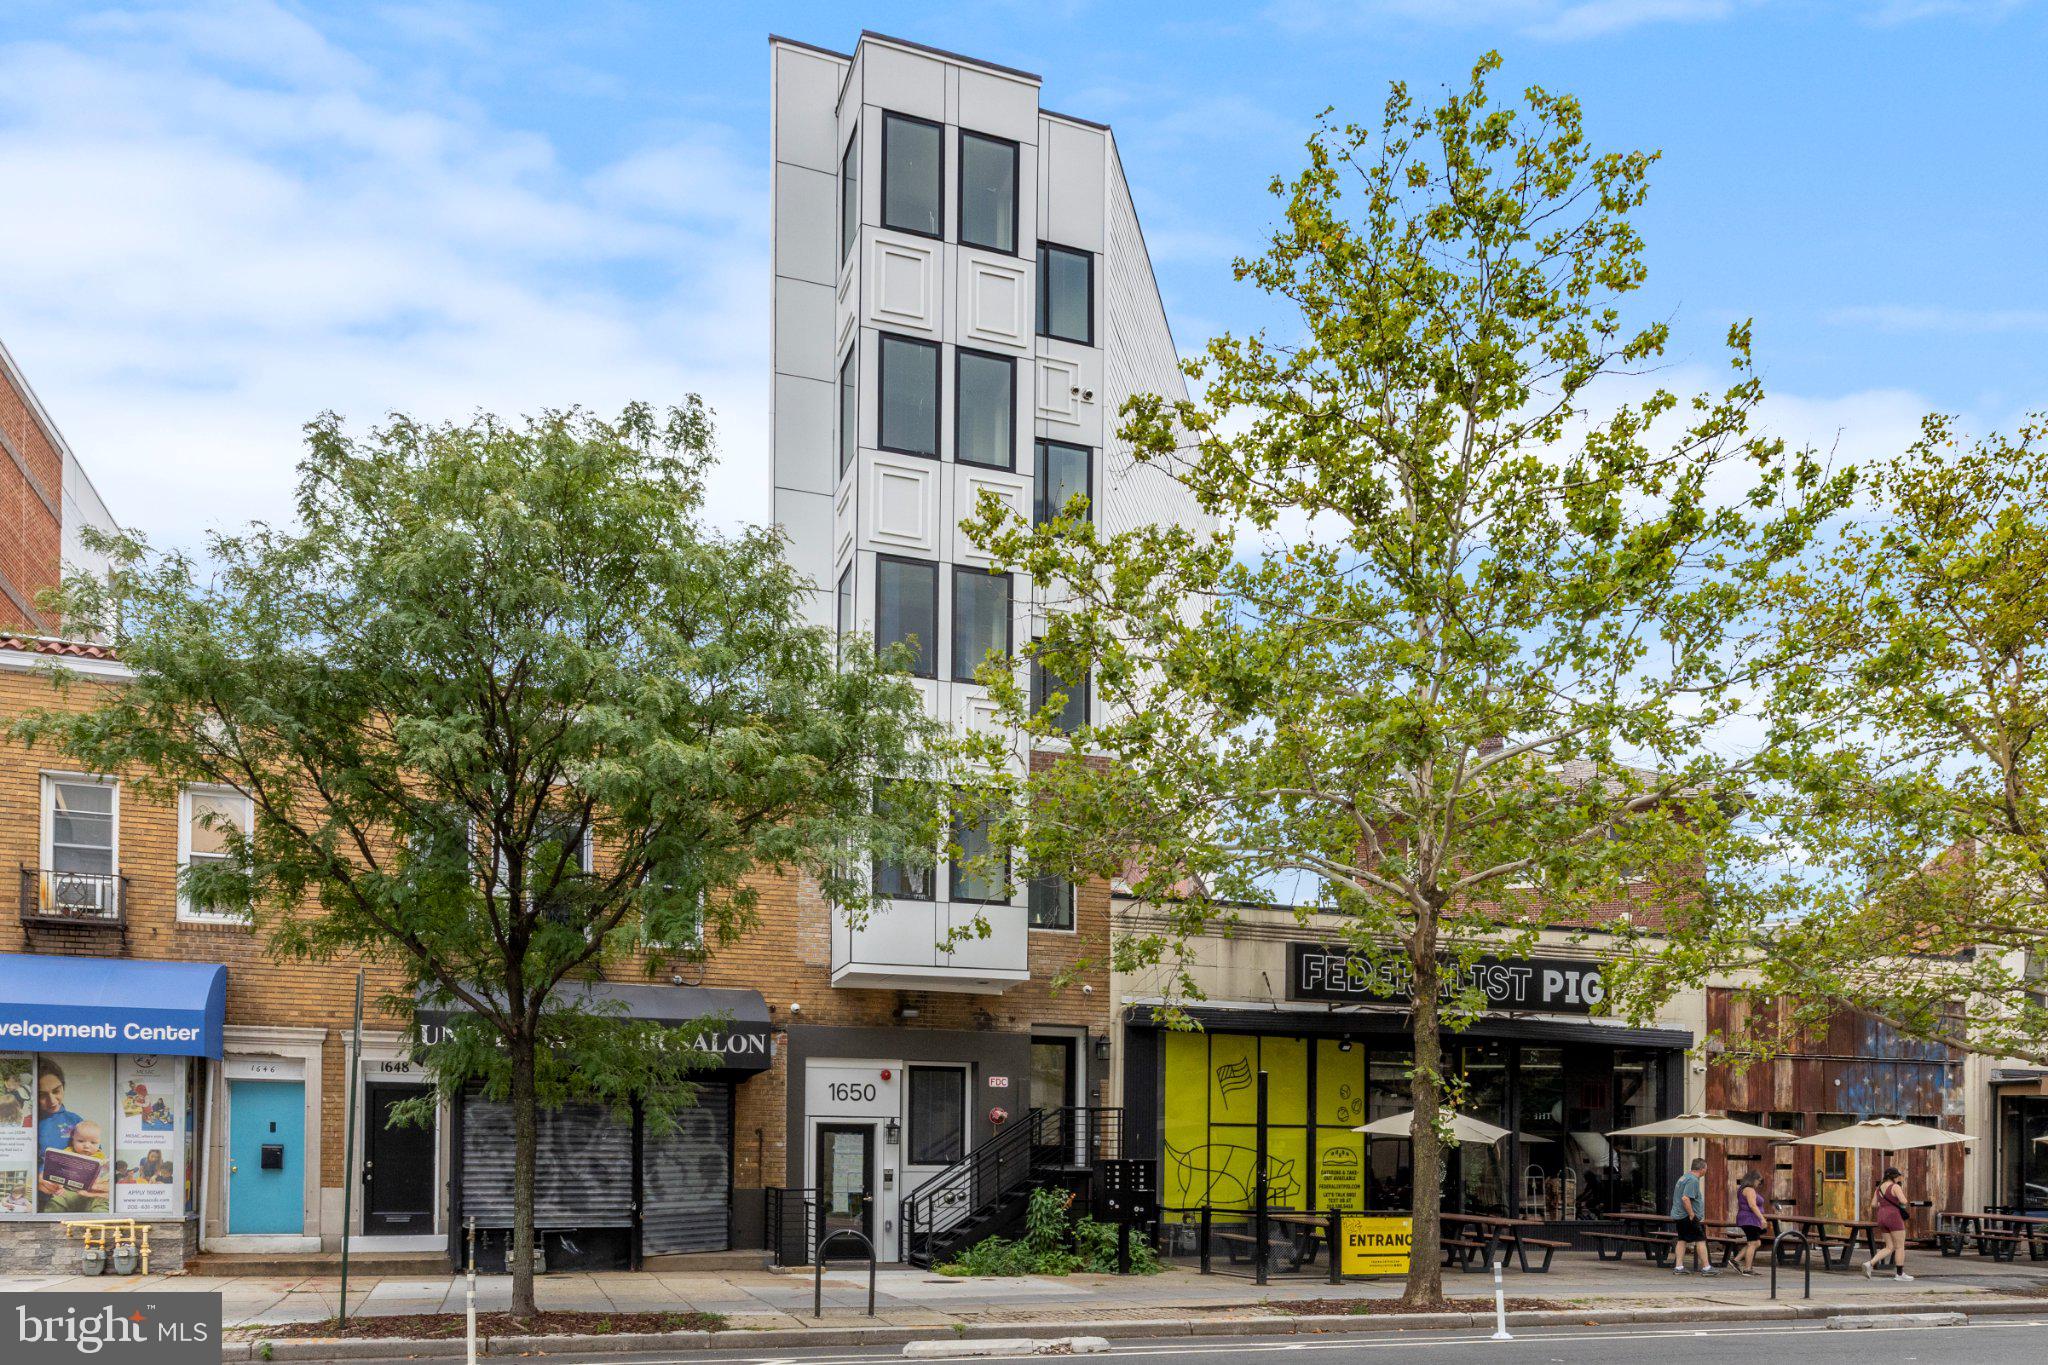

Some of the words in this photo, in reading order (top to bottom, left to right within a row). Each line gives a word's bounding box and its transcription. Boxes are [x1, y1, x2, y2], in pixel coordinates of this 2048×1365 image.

[1303, 954, 1532, 1000] FEDERLIST
[1543, 969, 1605, 1004] PIG
[0, 1020, 117, 1042] velopment
[123, 1022, 200, 1041] Center
[251, 1064, 275, 1073] 1646
[380, 1061, 410, 1073] 1648
[990, 1078, 1007, 1086] FDC
[828, 1083, 876, 1101] 1650
[1349, 1234, 1412, 1247] ENTRANC
